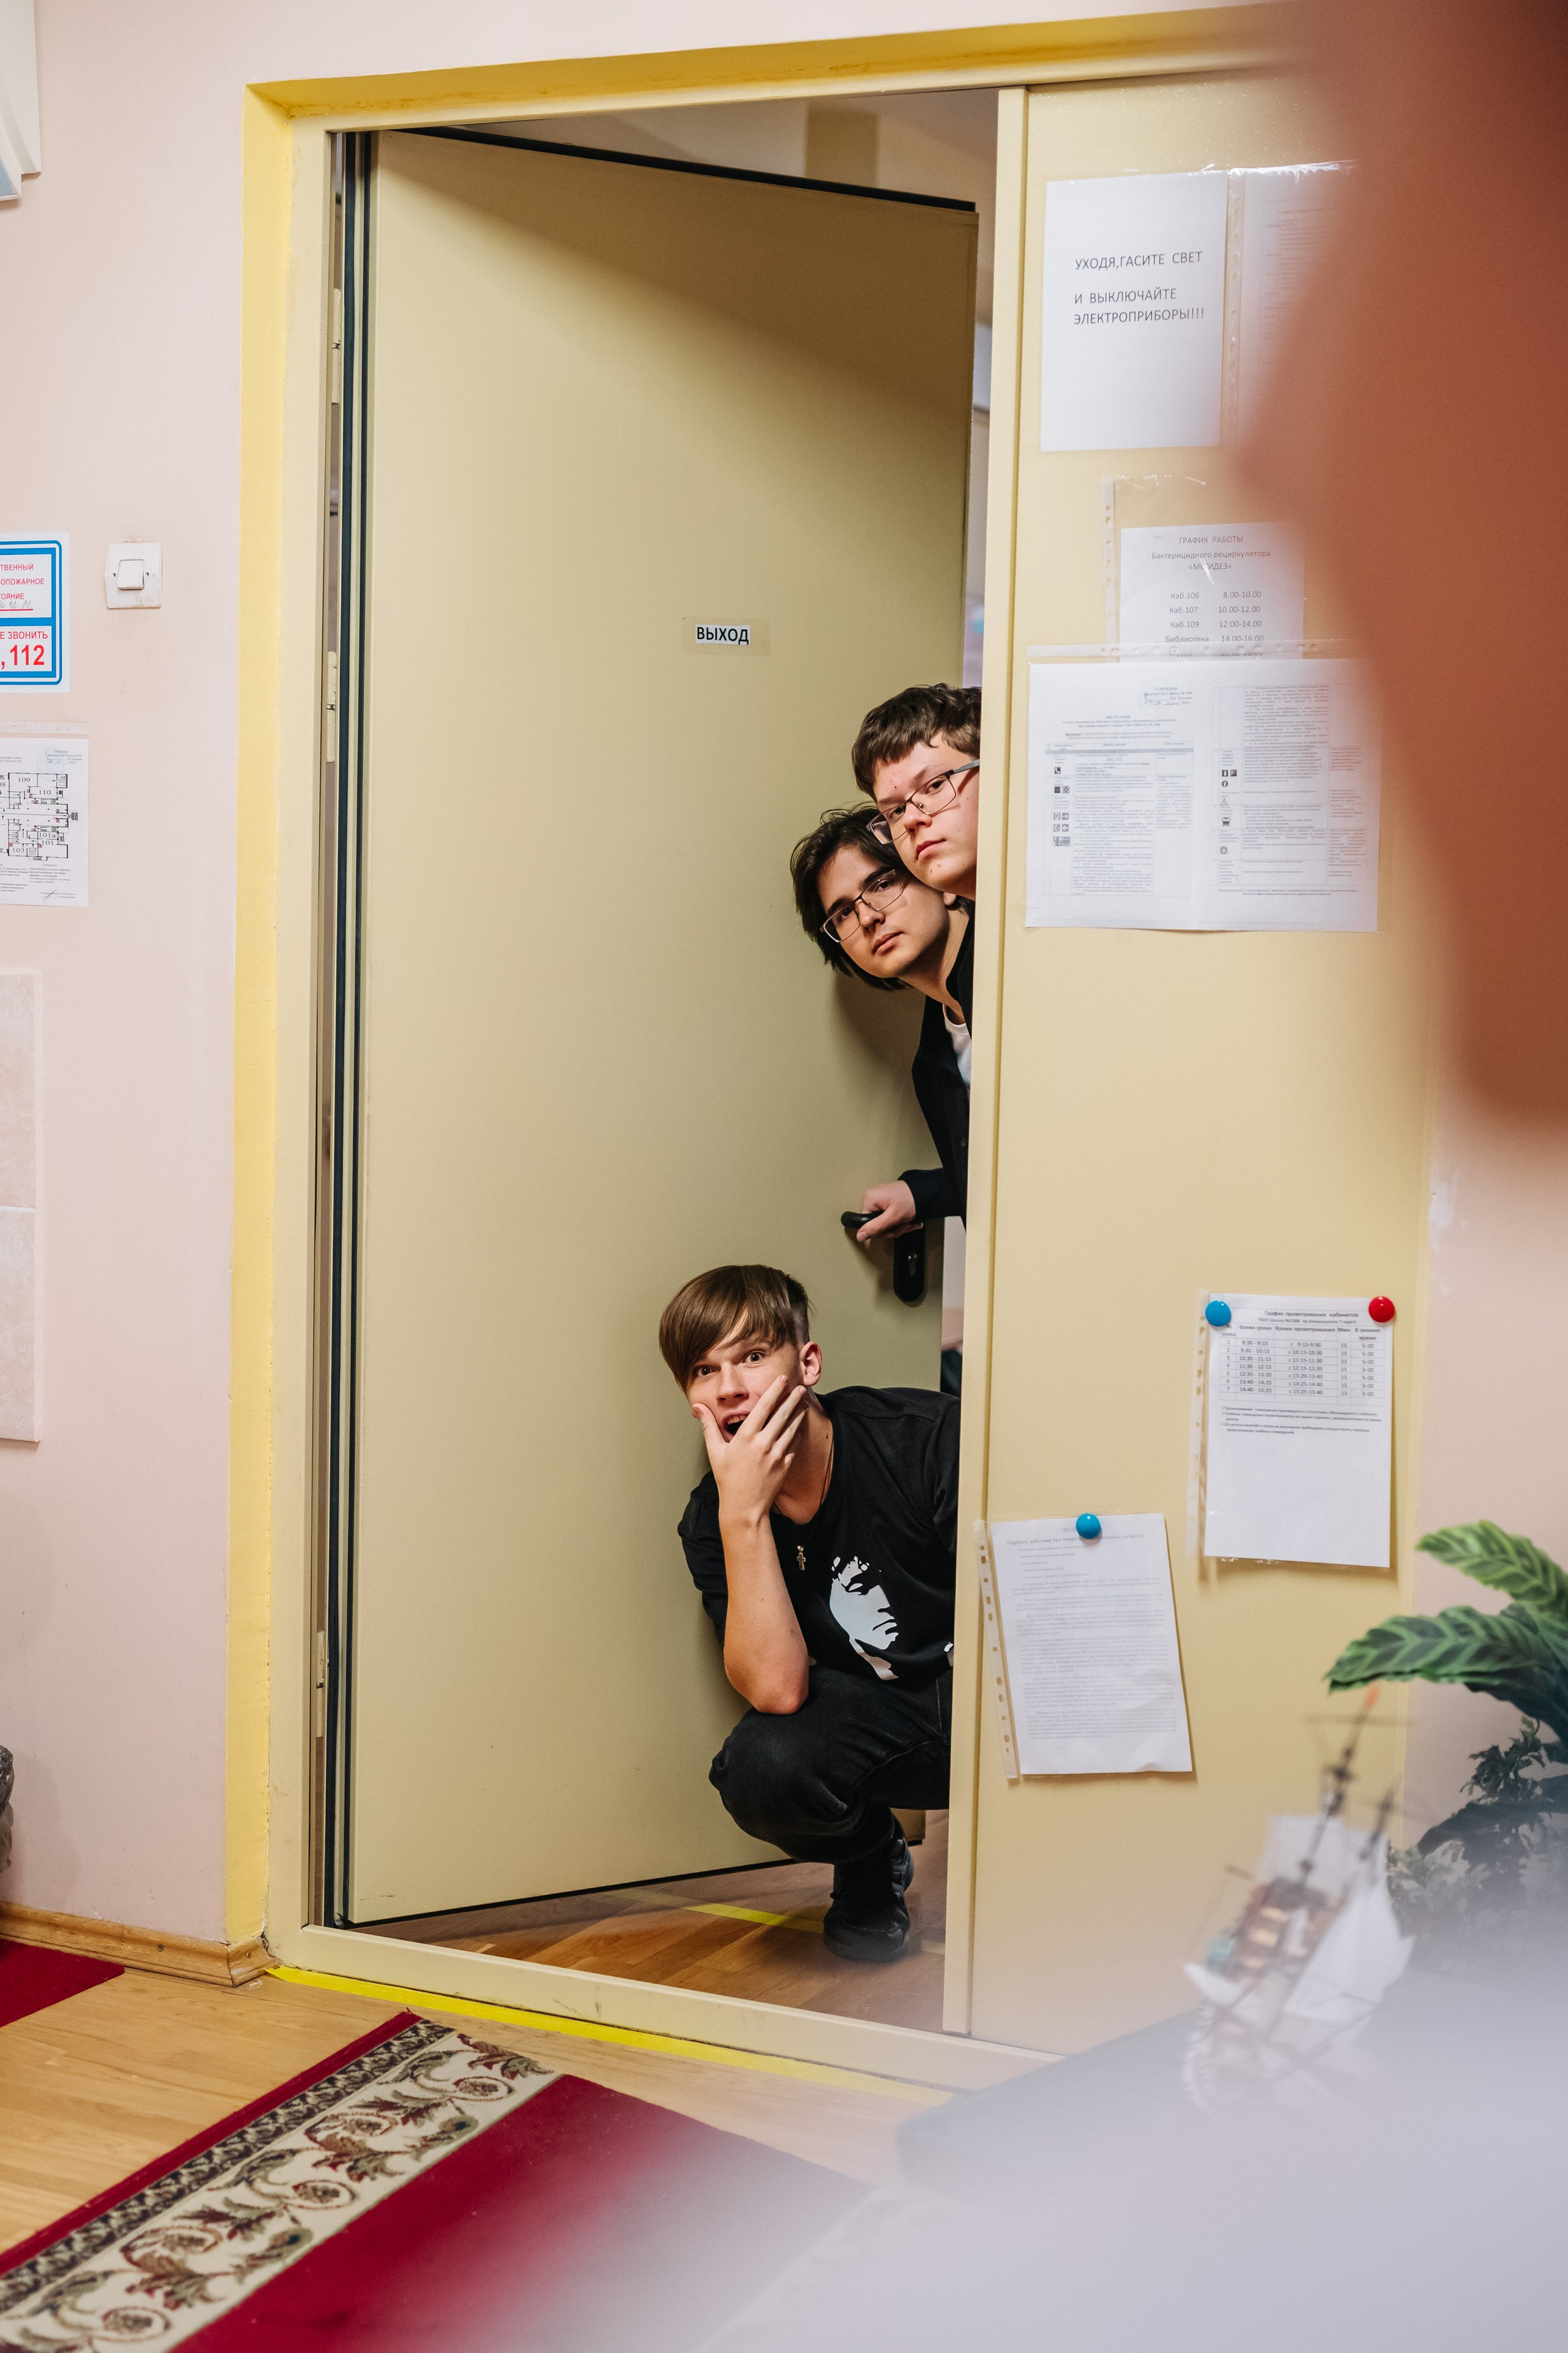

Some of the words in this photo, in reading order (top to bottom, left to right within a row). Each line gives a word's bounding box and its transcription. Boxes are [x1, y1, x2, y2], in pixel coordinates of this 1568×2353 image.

[1075, 253, 1165, 271] УХОДЯ,ГАСИТЕ
[1172, 251, 1203, 264] СВЕТ
[1074, 293, 1083, 304] И
[1090, 286, 1177, 304] ВЫКЛЮЧАЙТЕ
[1074, 307, 1204, 325] ЭЛЕКТРОПРИБОРЫ!!!
[7, 630, 48, 640] ЗВОНИТЬ
[696, 626, 749, 645] ВЫХОД
[10, 644, 45, 666] 112
